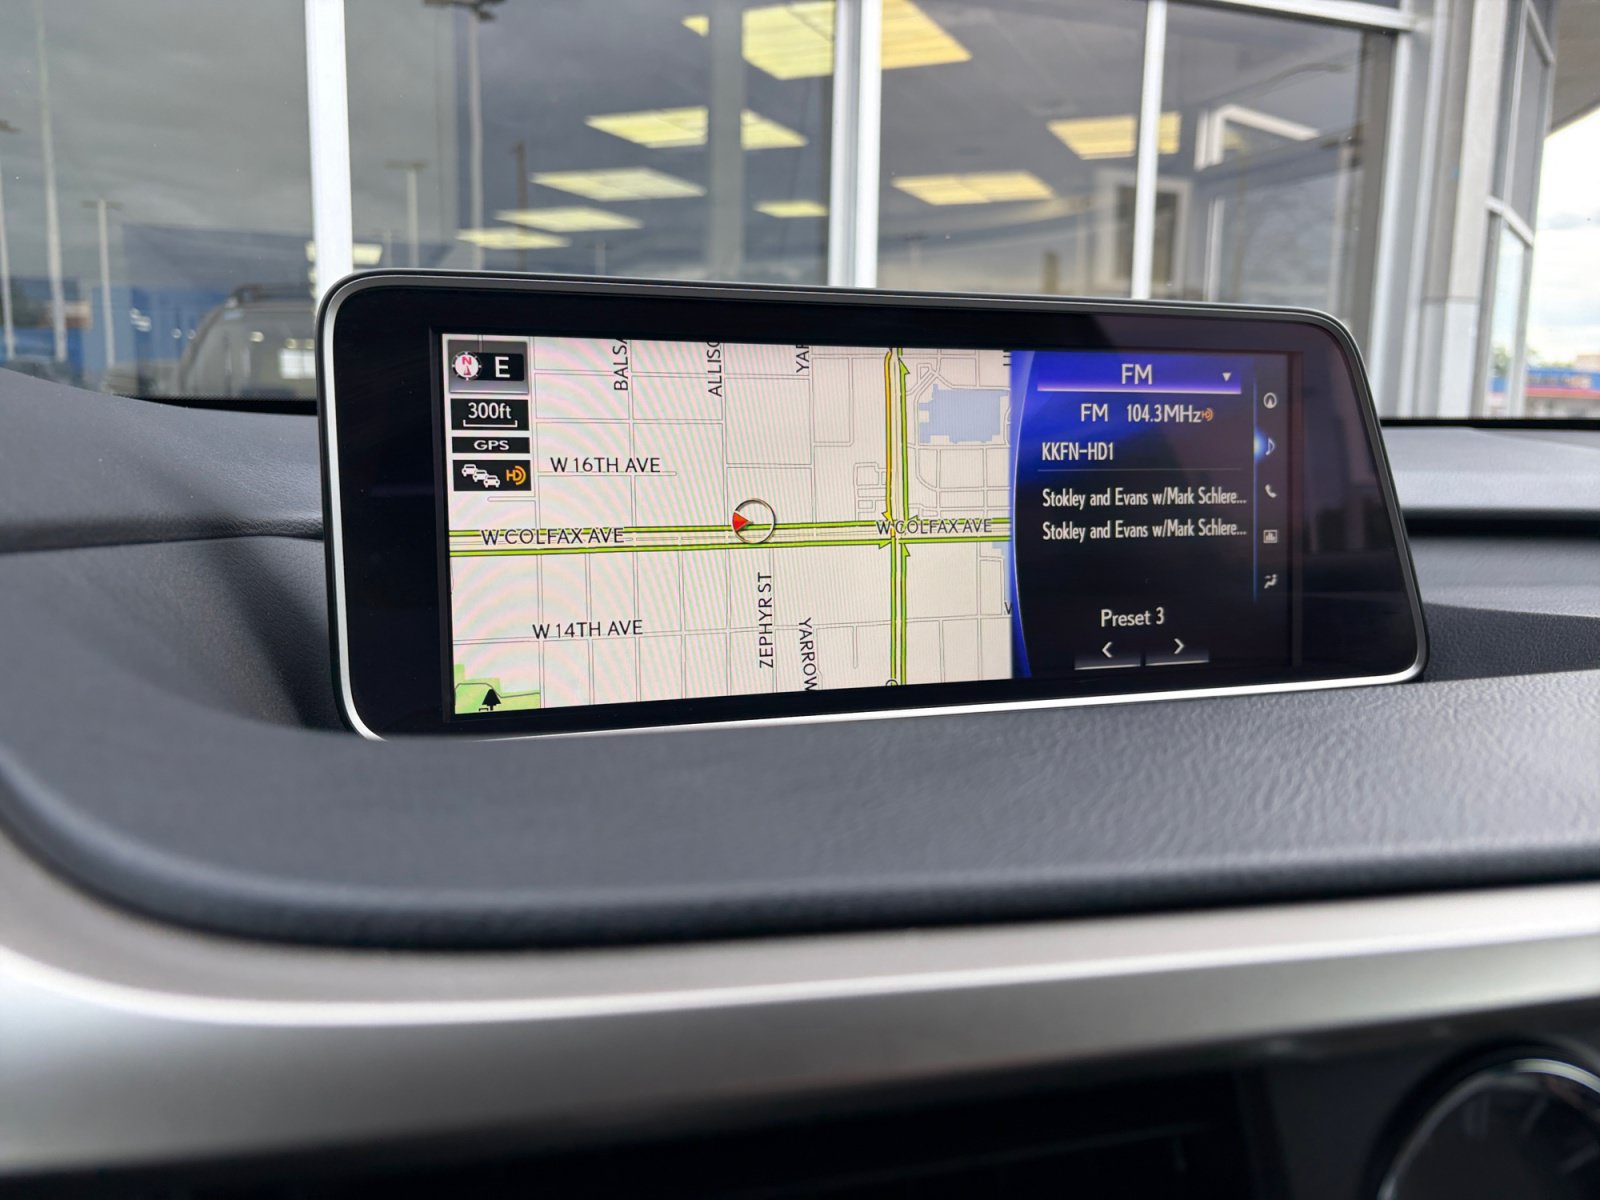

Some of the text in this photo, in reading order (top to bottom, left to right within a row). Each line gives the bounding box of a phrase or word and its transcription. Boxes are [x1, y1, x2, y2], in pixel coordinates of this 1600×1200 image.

[461, 356, 472, 366] N
[494, 356, 511, 378] E
[1121, 363, 1153, 385] FM
[467, 402, 512, 419] 300ft
[1080, 403, 1109, 422] FM
[1126, 403, 1202, 423] 104.3MHz
[473, 440, 510, 451] GPS
[1041, 441, 1114, 461] KKFN-HD1
[550, 457, 661, 473] W 16TH AVE
[1042, 486, 1247, 510] Stokley and Evans w/Mark Schlere...
[876, 518, 993, 535] W COLFAX AVE
[1042, 518, 1247, 543] Stokley and Evans w/Mark Schlere...
[481, 528, 625, 546] W COLFAX AVE
[757, 572, 774, 669] ZEPHYR ST
[1100, 607, 1165, 628] Preset 3
[532, 620, 643, 640] W 14TH AVE
[798, 617, 818, 691] YARROW
